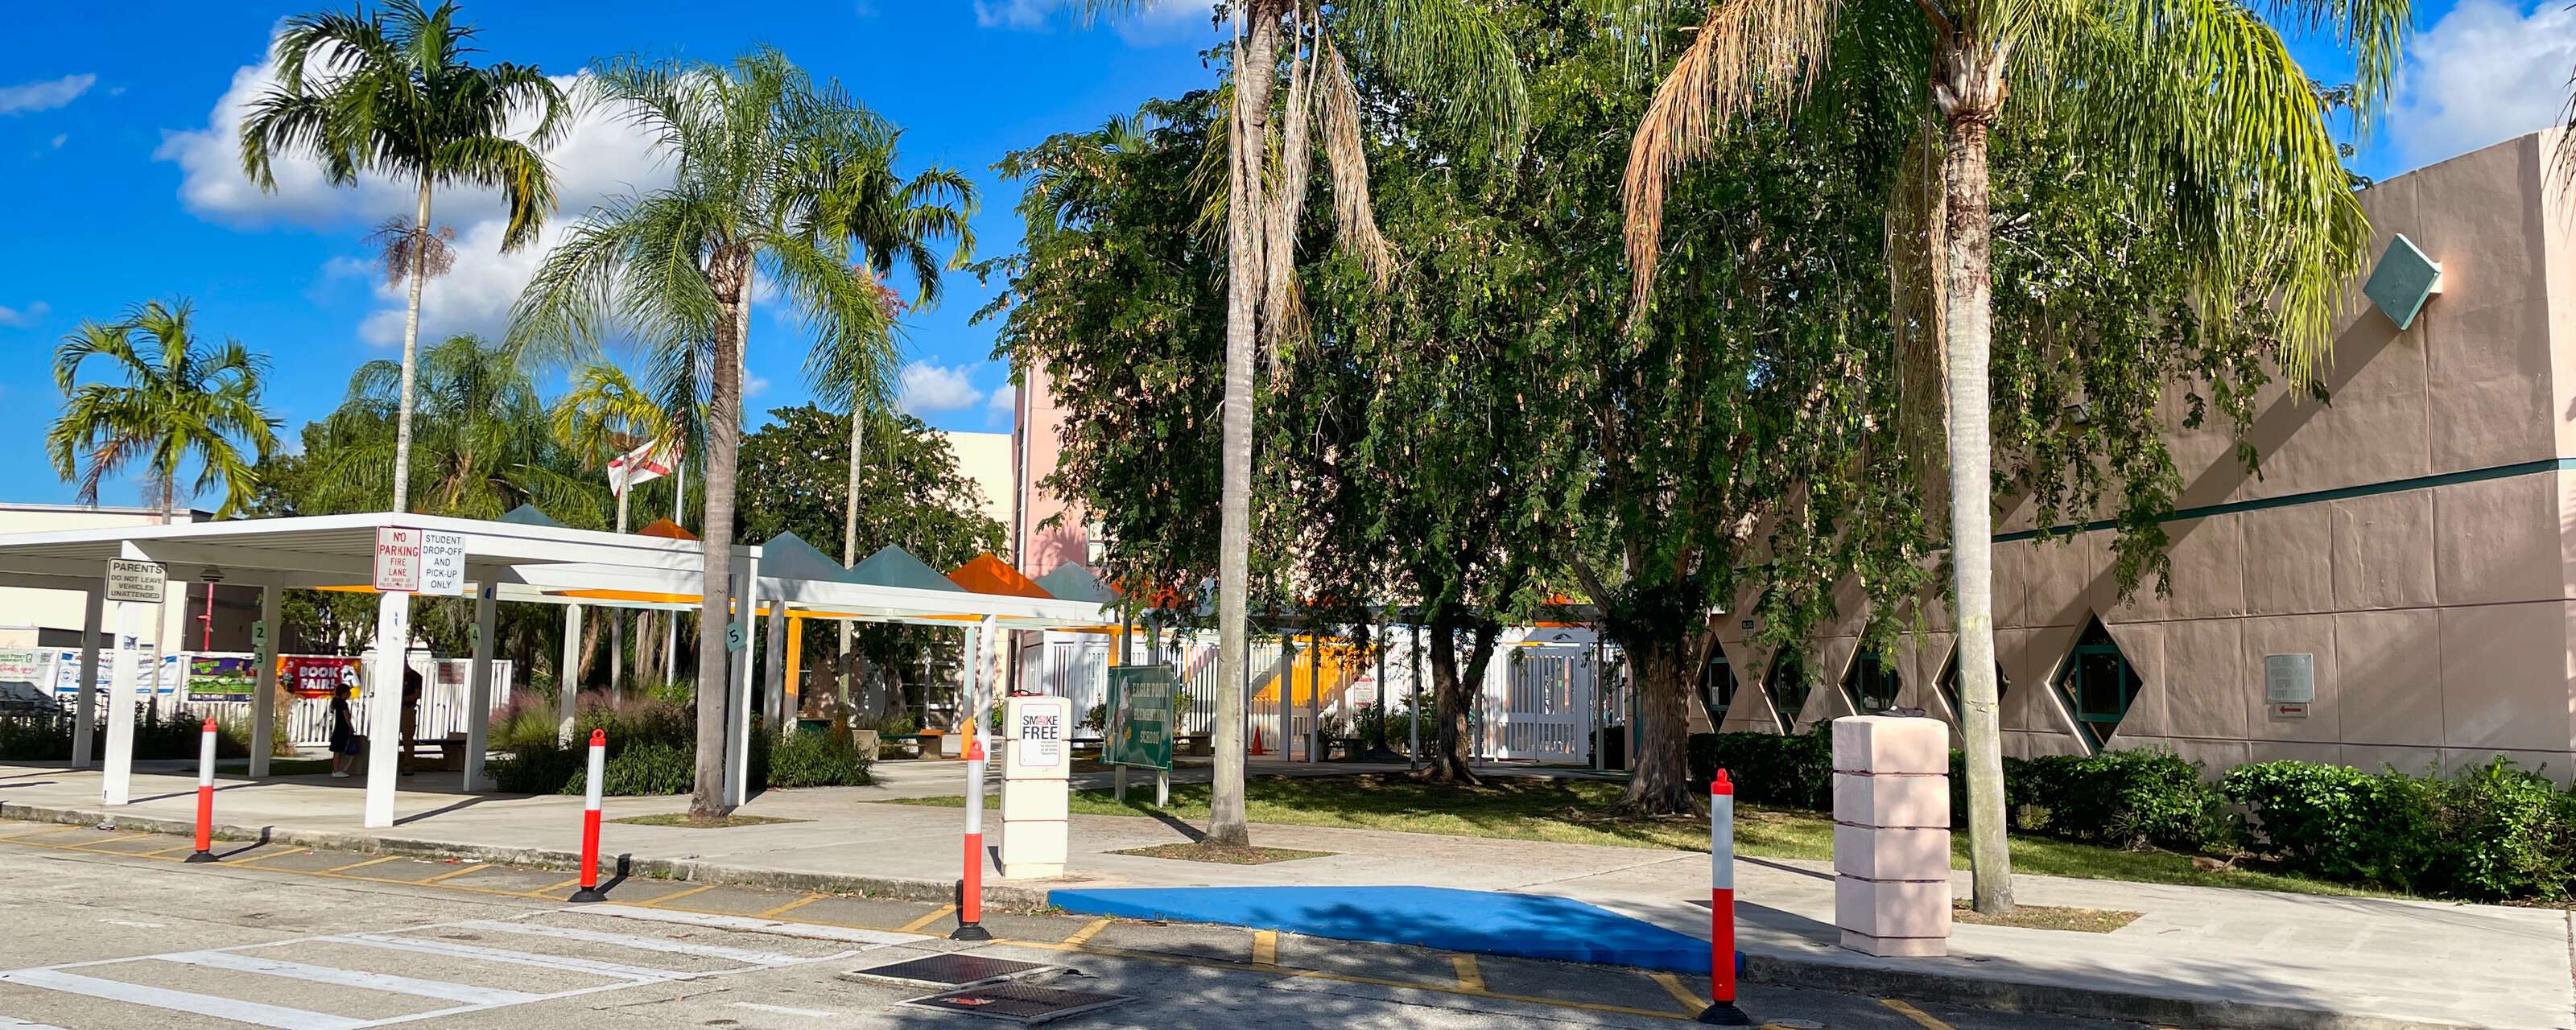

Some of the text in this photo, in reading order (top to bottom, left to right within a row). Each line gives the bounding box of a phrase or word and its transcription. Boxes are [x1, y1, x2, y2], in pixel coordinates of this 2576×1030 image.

[393, 532, 407, 542] NO
[426, 535, 462, 545] STUDENT
[379, 545, 419, 557] PARKING
[423, 546, 463, 556] DROP-OFF
[390, 558, 407, 566] FIRE
[433, 558, 451, 566] AND
[114, 562, 163, 575] PARENTS
[388, 568, 407, 577] LANE
[426, 568, 457, 579] PICK-UP
[118, 583, 155, 591] VEHICLES
[431, 580, 452, 589] ONLY
[110, 591, 160, 599] UNATTENDED
[257, 628, 264, 638] 2
[473, 629, 478, 641] 4
[729, 629, 739, 643] 5
[257, 653, 263, 664] 3
[299, 666, 339, 678] BOOK
[300, 678, 336, 690] FAIR!
[1132, 682, 1170, 698] EAGLE POINT
[1133, 708, 1167, 722] ELEMENTARY
[1022, 726, 1059, 740] FREE
